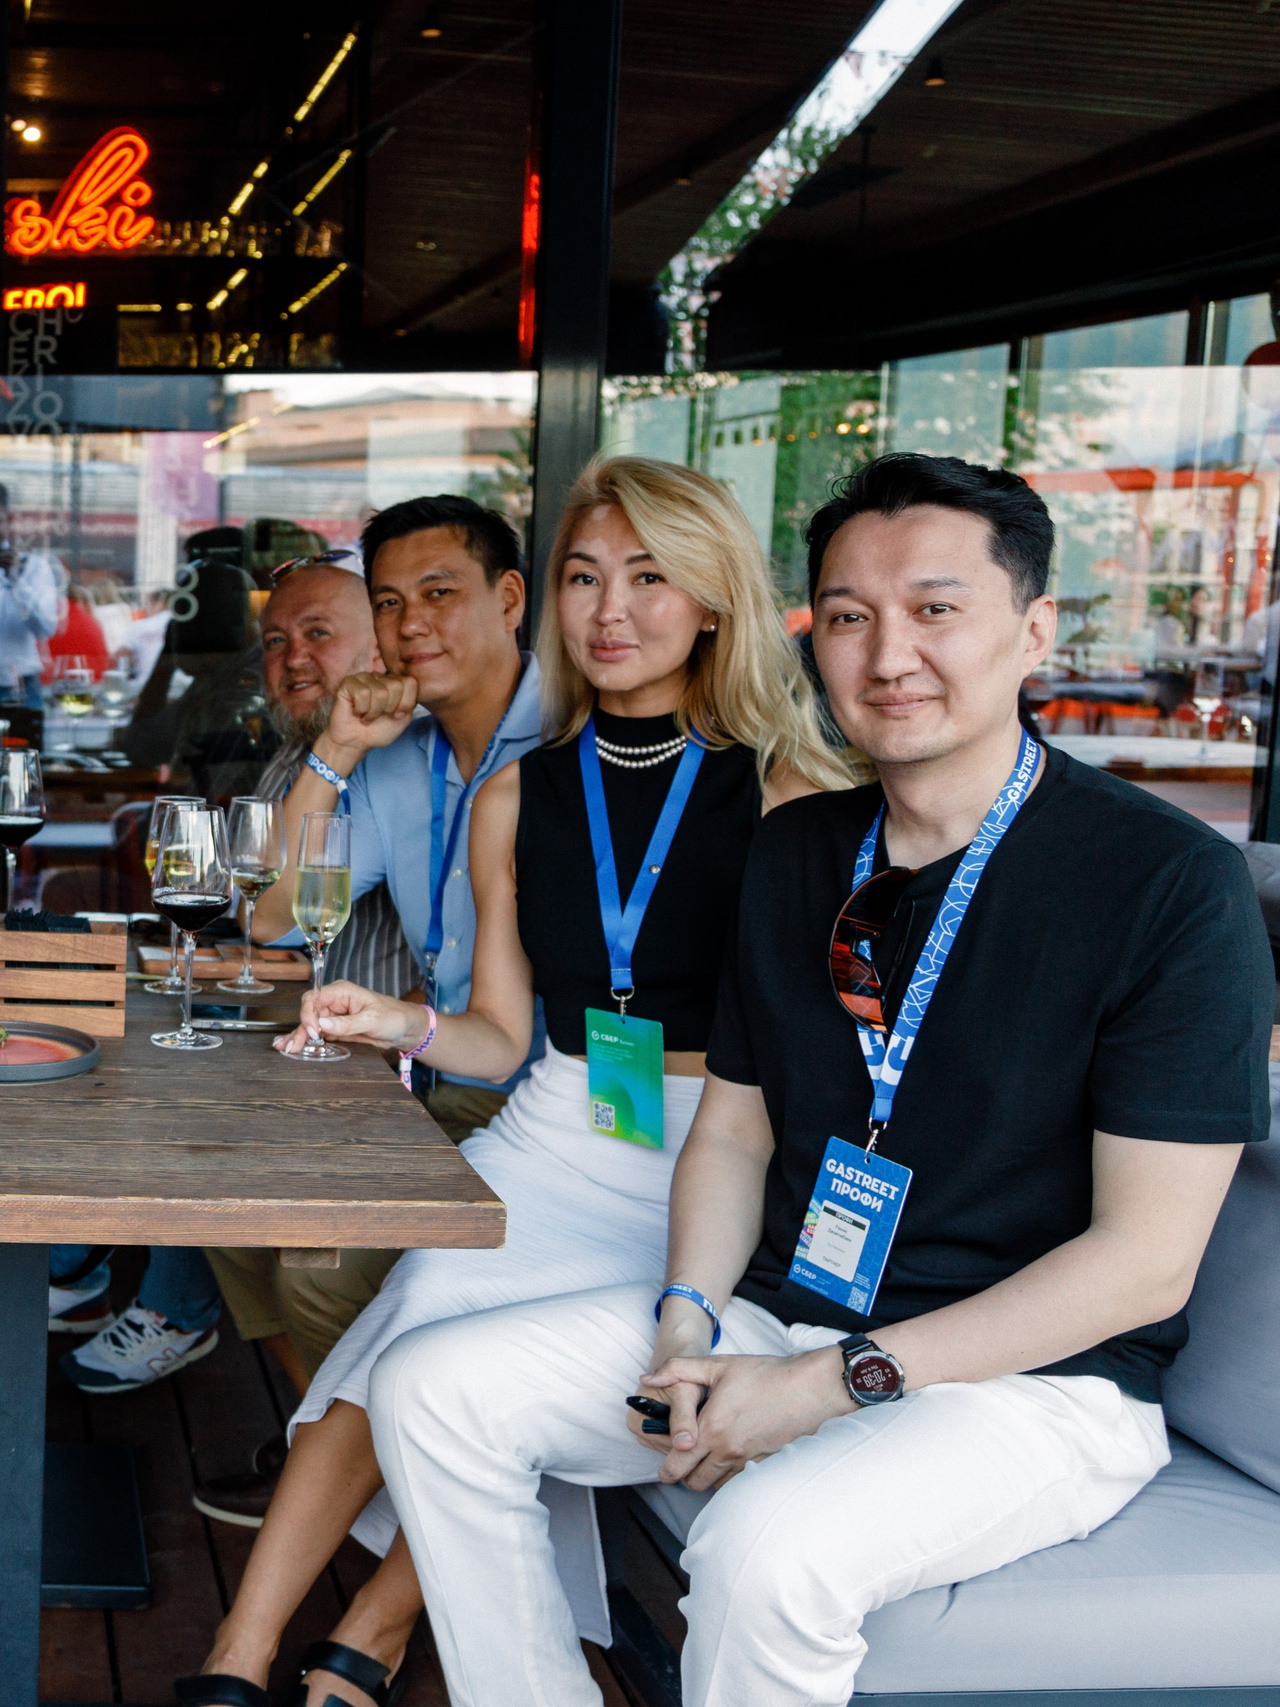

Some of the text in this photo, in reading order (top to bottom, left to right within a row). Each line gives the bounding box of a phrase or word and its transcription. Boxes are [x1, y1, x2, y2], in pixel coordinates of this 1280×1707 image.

[1007, 736, 1037, 801] GASTREET
[825, 1158, 899, 1200] GASTREET
[830, 1178, 884, 1212] ПРОФИ
[862, 1369, 886, 1388] 20:39
